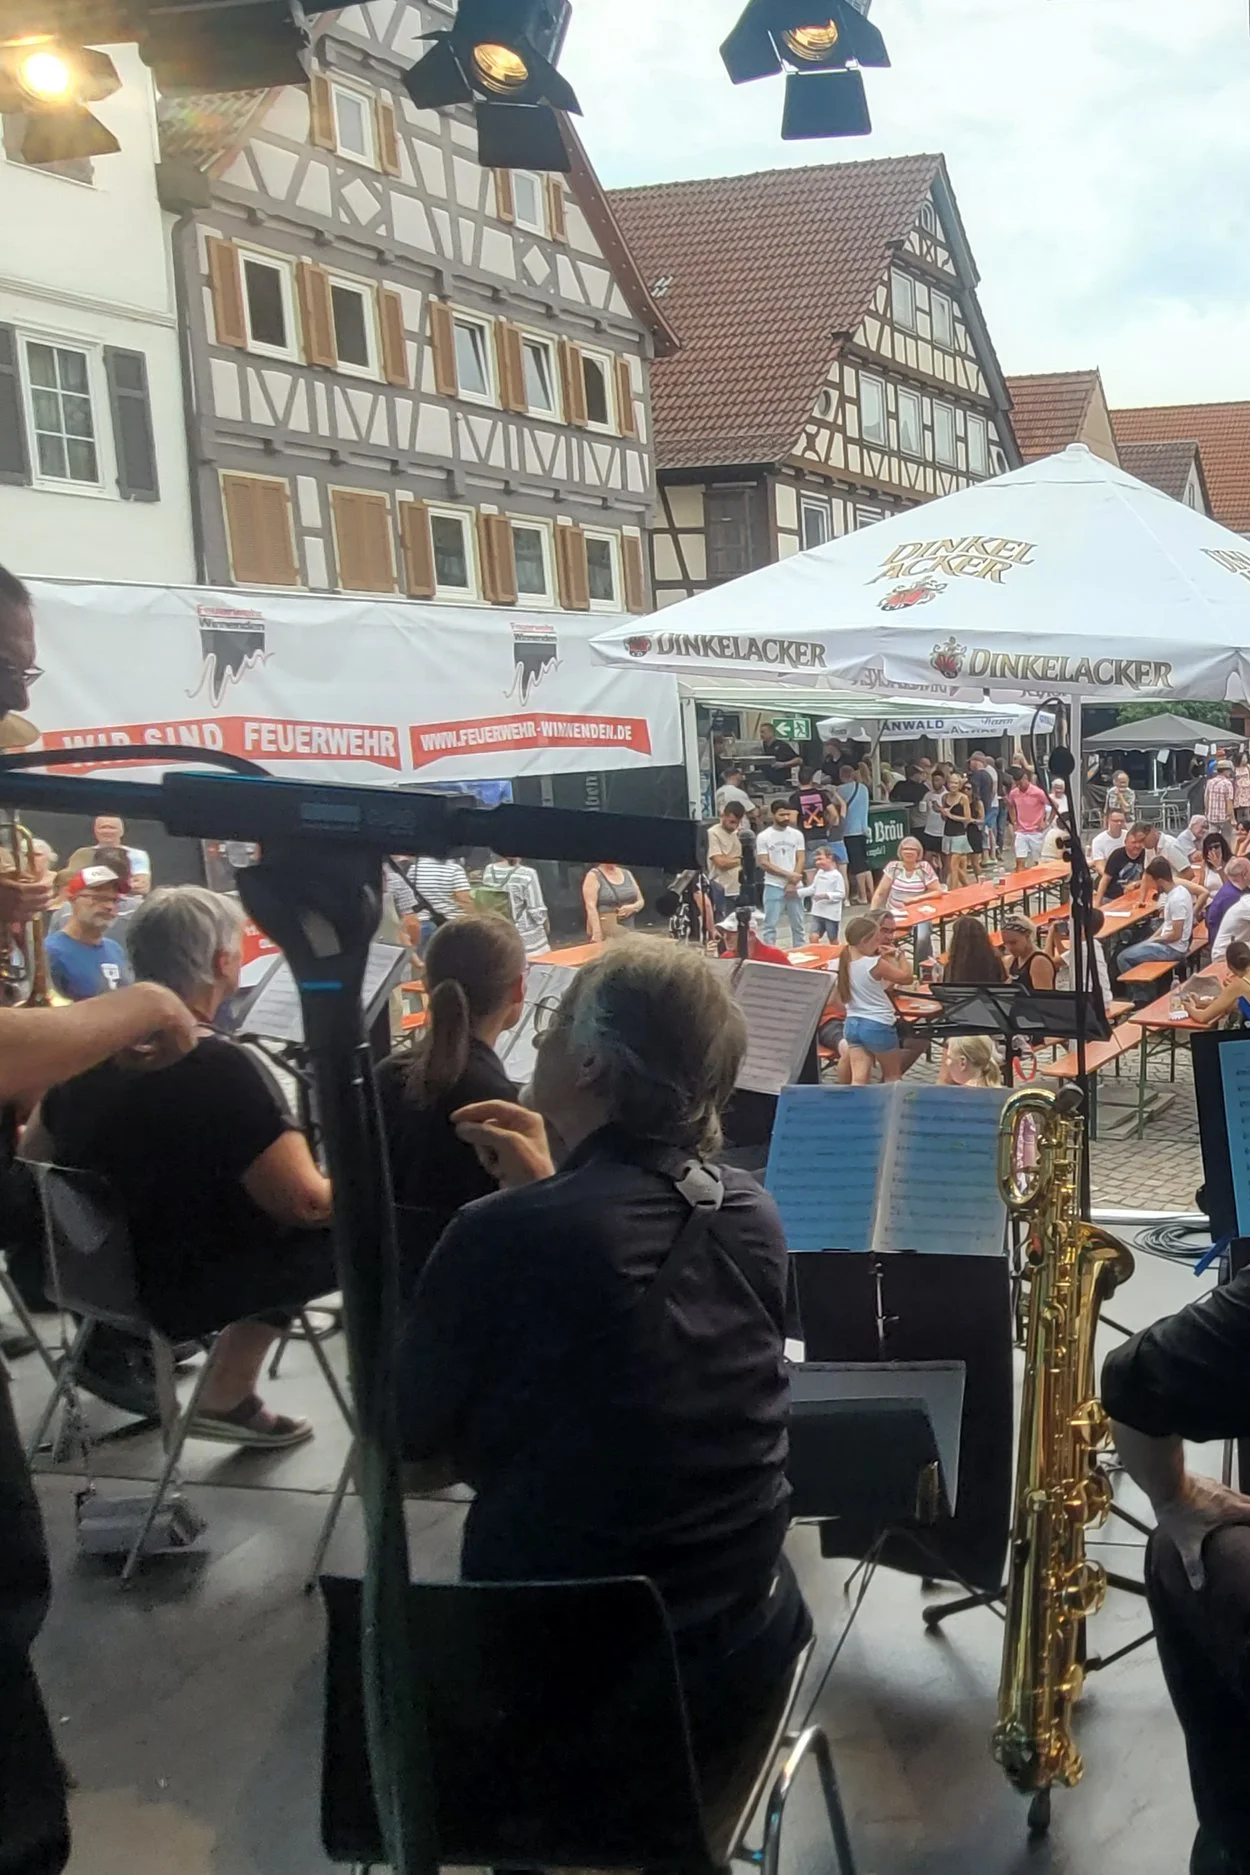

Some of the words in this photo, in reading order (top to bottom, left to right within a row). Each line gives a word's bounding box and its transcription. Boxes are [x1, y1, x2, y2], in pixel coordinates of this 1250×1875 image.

[878, 535, 1039, 567] DINKEL
[863, 553, 1009, 585] ACKER
[656, 632, 828, 669] DINKELACKER
[968, 647, 1174, 690] DINKELACKER
[243, 721, 397, 758] FEUERWEHR
[419, 719, 633, 752] WWW.FEUERWEHR-WINNENDEN.DE
[880, 719, 945, 732] ANWALD
[874, 820, 905, 843] Bräu
